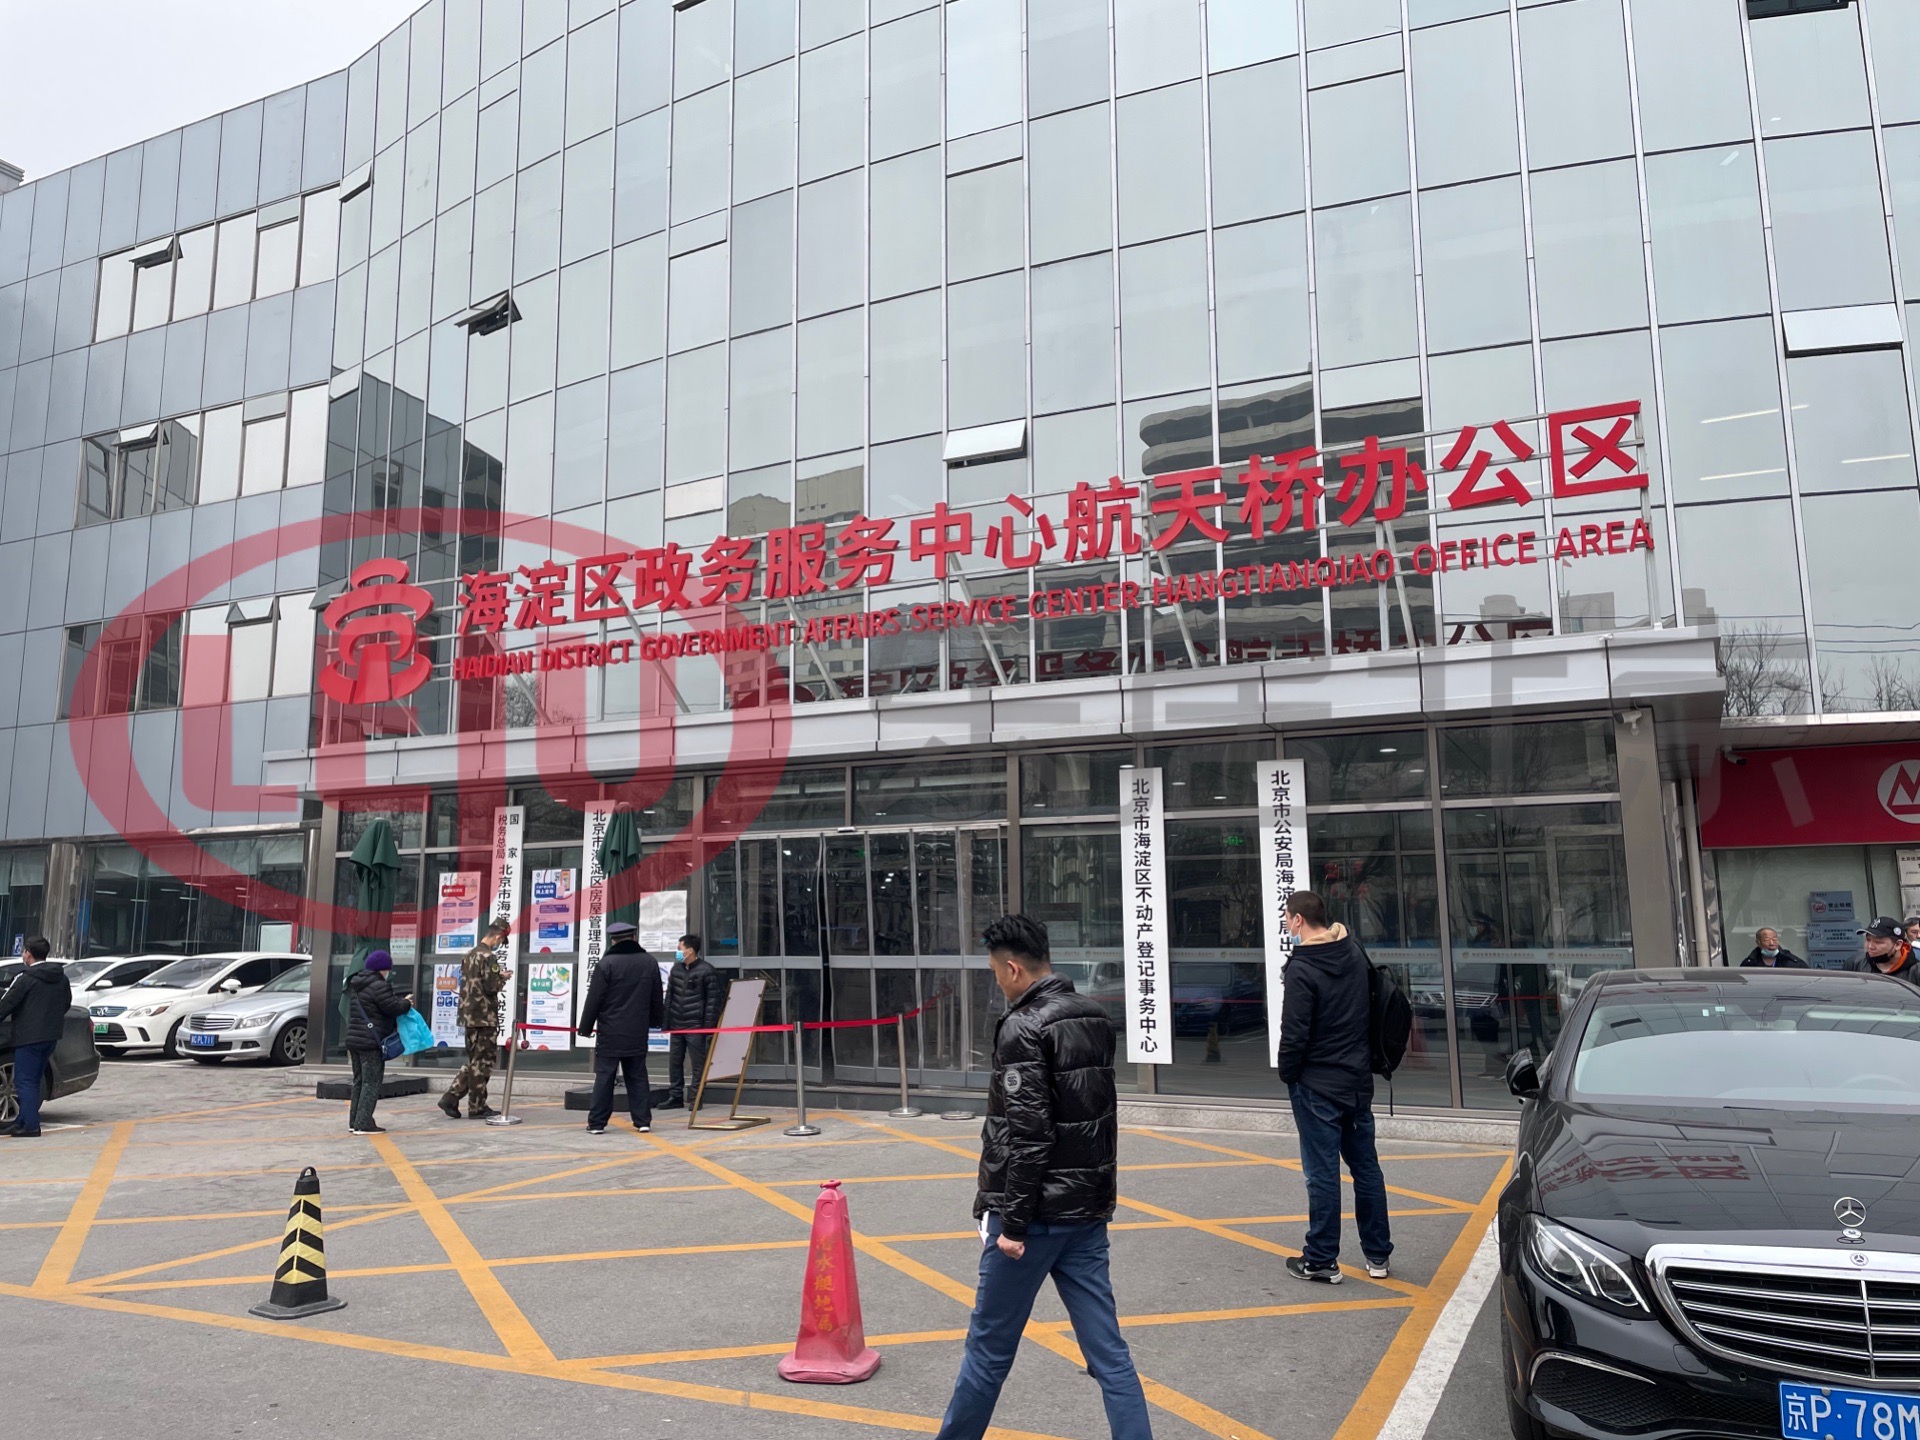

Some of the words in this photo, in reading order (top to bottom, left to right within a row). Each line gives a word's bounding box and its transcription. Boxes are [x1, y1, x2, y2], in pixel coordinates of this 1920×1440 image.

[453, 650, 534, 681] HAIDIAN
[540, 638, 634, 672] DISTRICT
[640, 621, 796, 662] GOVERNMENT
[804, 609, 900, 644] AFFAIRS
[911, 594, 1017, 633] SERVICE
[1029, 581, 1140, 620] CENTER
[1153, 548, 1395, 606] HANGTIANQIAO
[1413, 531, 1538, 576] OFFICE
[1554, 517, 1656, 561] AREA
[458, 401, 1650, 636] 海淀区政务服务中心航天桥办公区
[1132, 778, 1158, 1053] 北京市海淀区不动产登记事务中心
